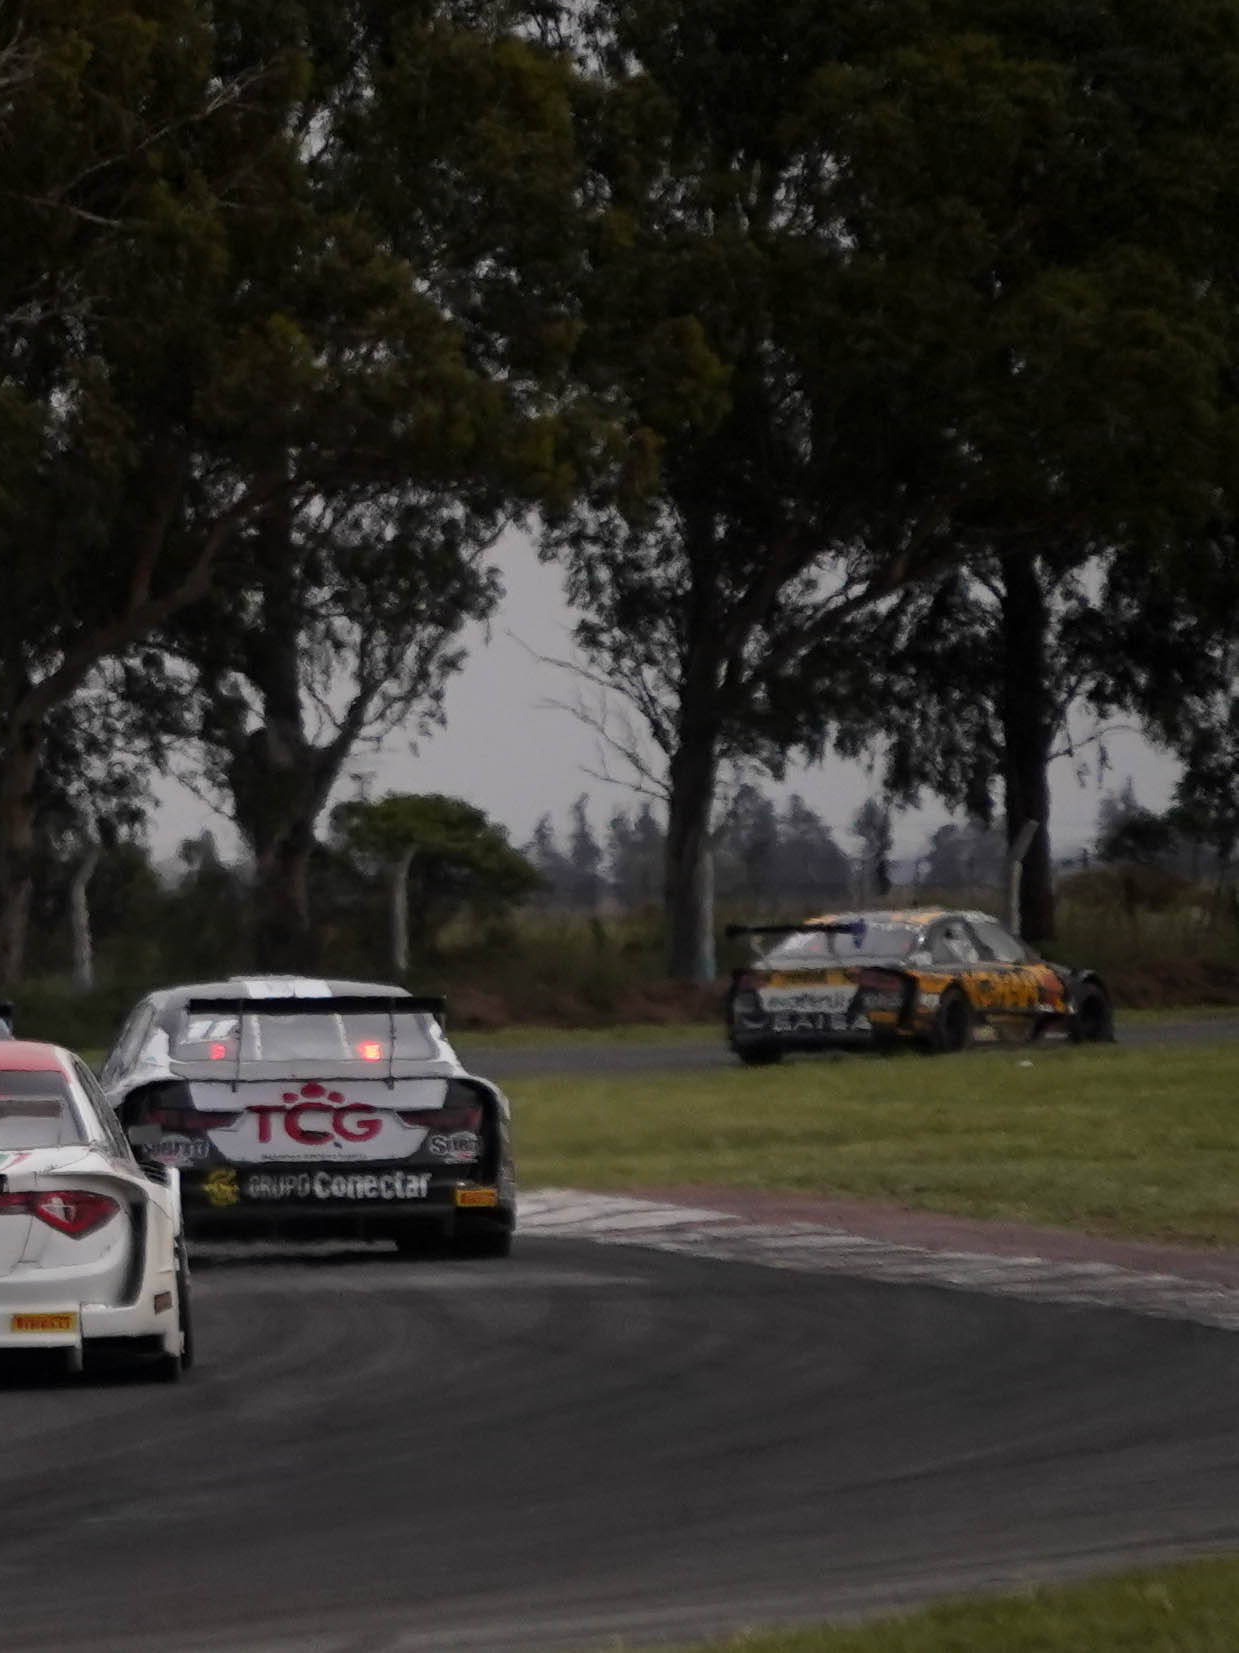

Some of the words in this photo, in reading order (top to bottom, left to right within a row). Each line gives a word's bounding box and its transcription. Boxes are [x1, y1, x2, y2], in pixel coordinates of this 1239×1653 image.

[245, 1102, 382, 1146] TCG
[248, 1174, 311, 1199] GRUPO
[313, 1171, 432, 1200] Conectar
